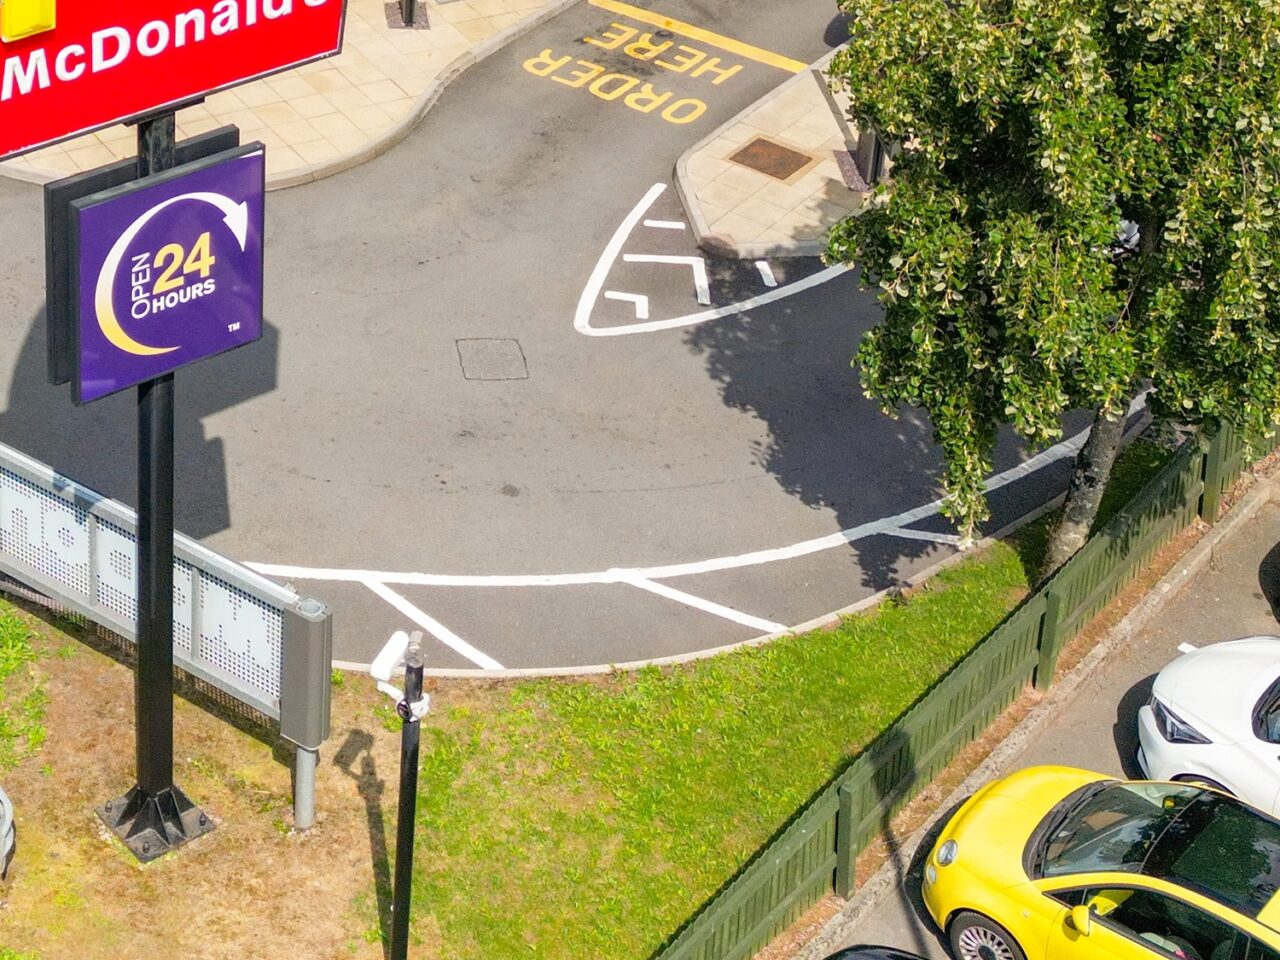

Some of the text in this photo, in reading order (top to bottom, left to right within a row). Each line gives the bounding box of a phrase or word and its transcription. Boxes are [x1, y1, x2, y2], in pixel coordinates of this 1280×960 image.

[583, 21, 744, 84] HERE
[522, 49, 708, 124] ORDER
[131, 252, 151, 319] OPEN
[152, 278, 216, 314] HOURS
[153, 231, 216, 296] 24
